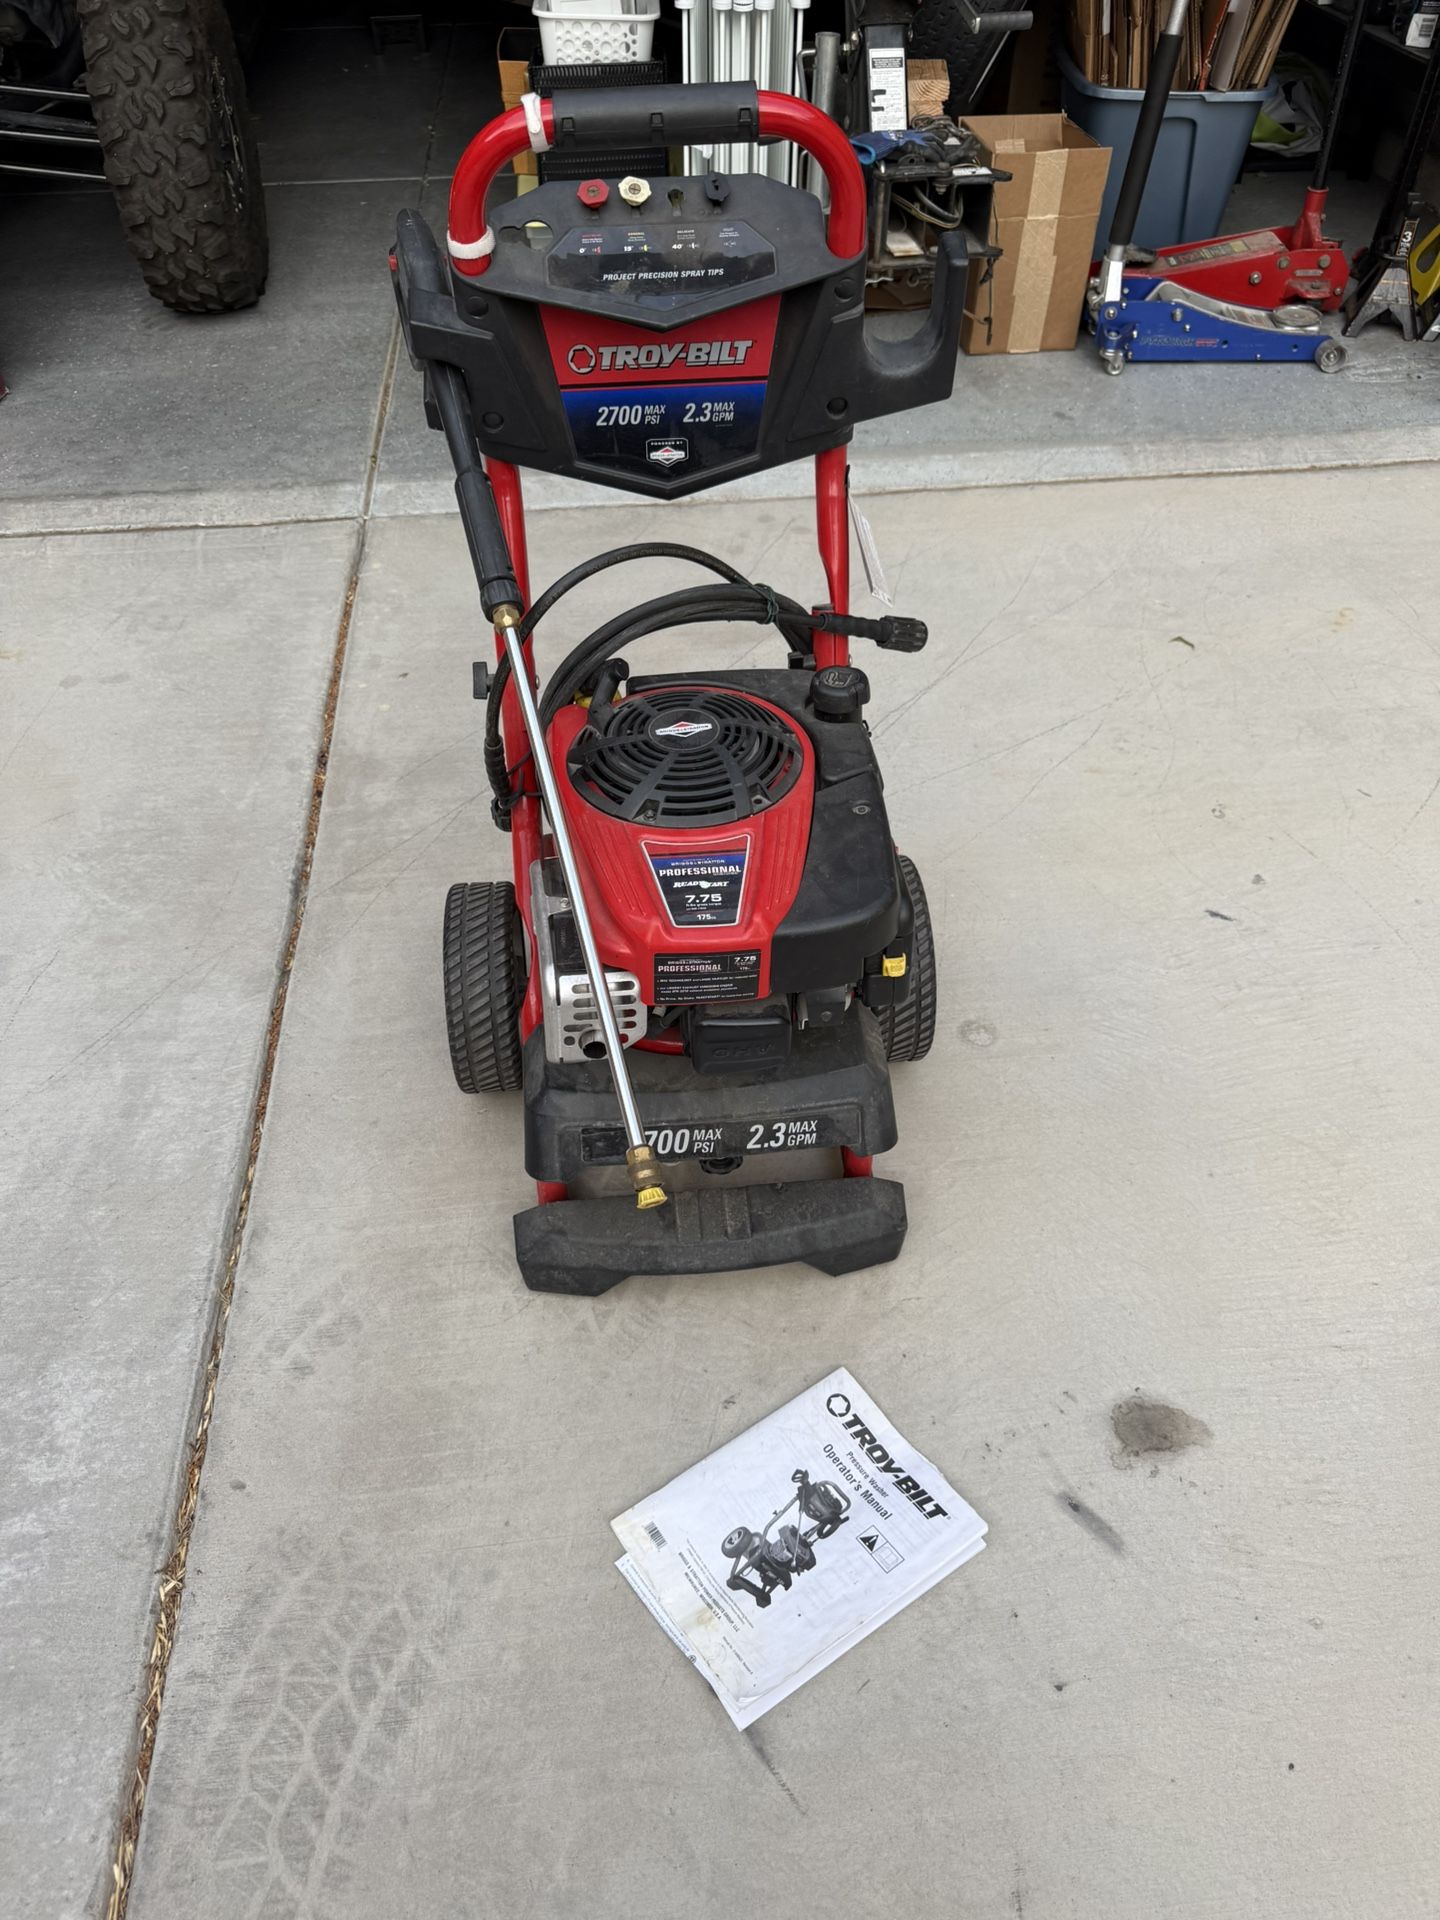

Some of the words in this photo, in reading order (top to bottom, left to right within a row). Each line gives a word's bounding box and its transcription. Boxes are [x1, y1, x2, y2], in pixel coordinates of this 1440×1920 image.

[1402, 231, 1412, 242] 3
[602, 272, 635, 281] PROJECT
[637, 271, 679, 280] PRECISION
[680, 269, 706, 278] SPRAY
[707, 268, 724, 276] TIPS
[598, 340, 753, 370] TROY-BILT
[596, 405, 642, 426] 2700
[644, 405, 666, 415] MAX
[683, 402, 712, 423] 2.3
[712, 401, 735, 412] MAX
[712, 412, 735, 422] GPM
[645, 415, 660, 425] PSI
[659, 865, 741, 877] PROFESSIONAL
[685, 893, 722, 903] 7.75
[657, 964, 722, 972] PROFESSIONAL
[644, 1128, 690, 1155] 700
[693, 1127, 723, 1141] MAX
[746, 1122, 787, 1150] 2.3
[788, 1119, 818, 1133] MAX
[787, 1132, 817, 1146] GPM
[693, 1141, 714, 1154] PSI
[842, 1413, 949, 1520] TROY-BILT
[823, 1443, 863, 1492] Operator's
[860, 1489, 893, 1520] Manual
[846, 1450, 870, 1480] Pressure
[868, 1477, 889, 1499] Washer
